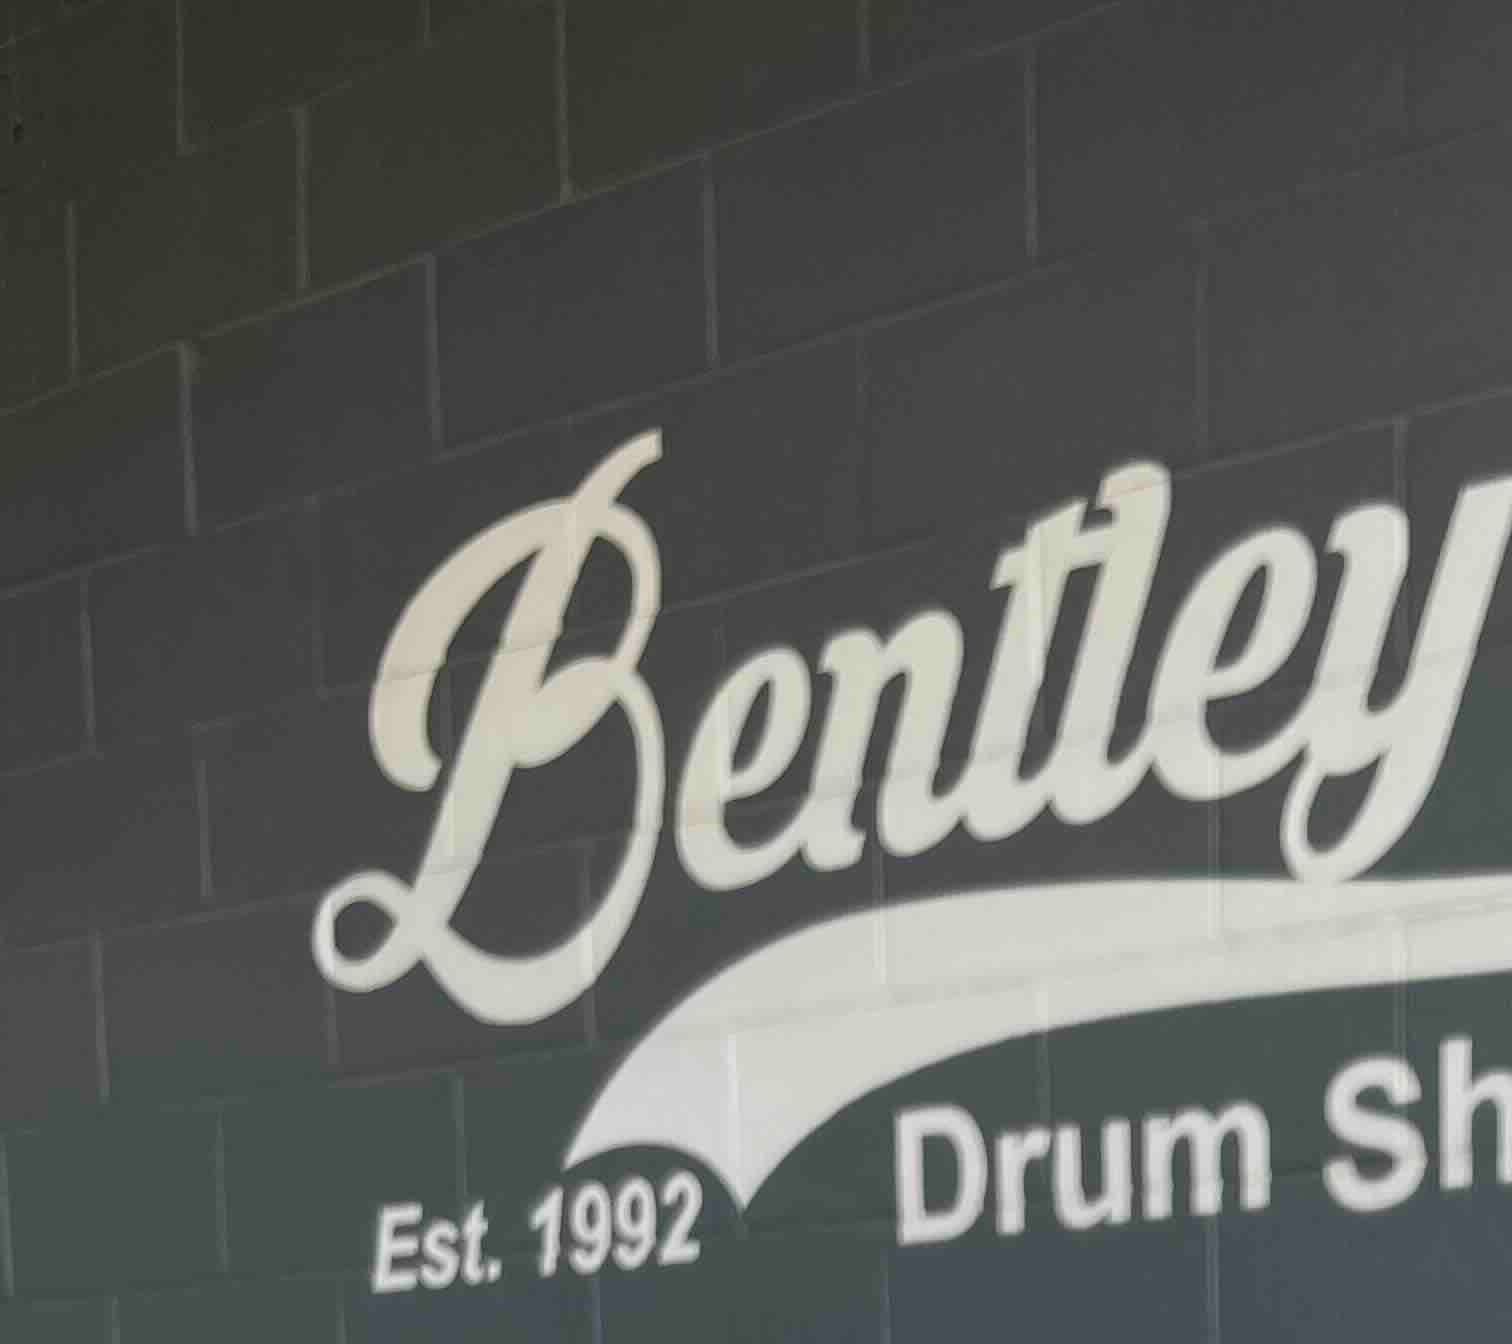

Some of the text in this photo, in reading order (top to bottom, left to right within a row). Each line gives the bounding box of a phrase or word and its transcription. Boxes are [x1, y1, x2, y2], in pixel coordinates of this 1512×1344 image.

[370, 1170, 704, 1294] Est. 1992
[894, 1102, 1274, 1246] Drum
